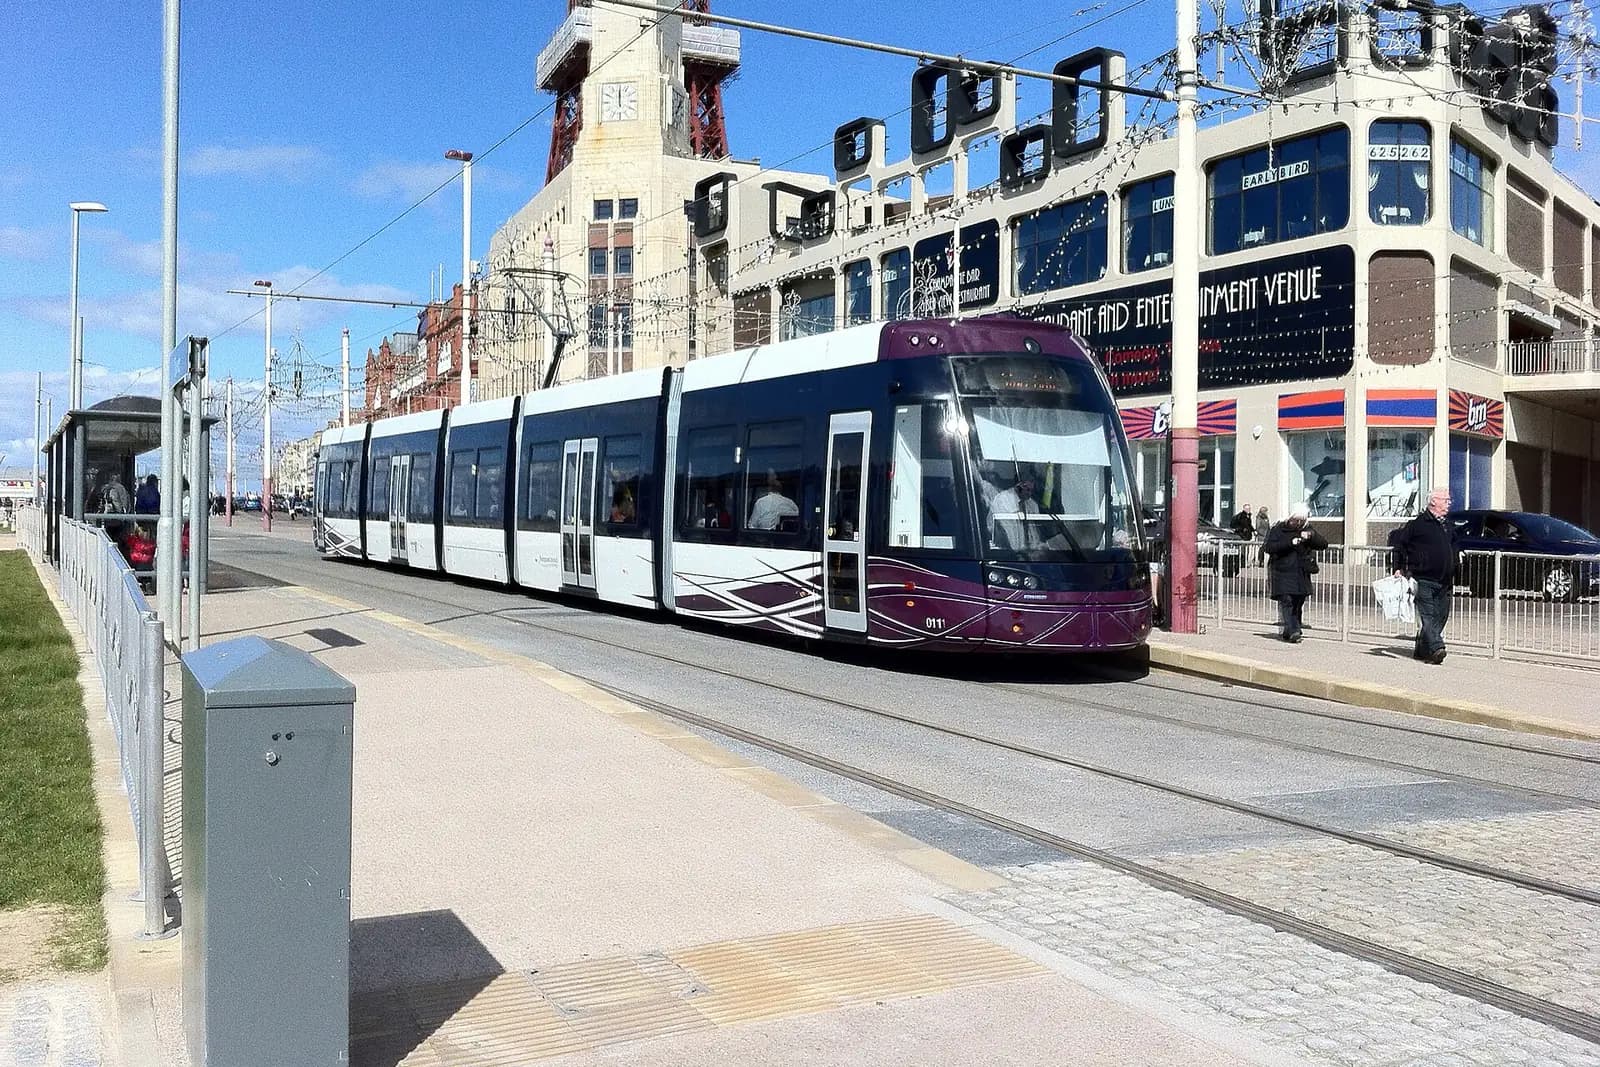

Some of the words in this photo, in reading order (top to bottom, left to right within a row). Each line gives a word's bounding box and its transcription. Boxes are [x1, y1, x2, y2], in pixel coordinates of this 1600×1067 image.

[1243, 169, 1278, 188] EARLY
[1280, 162, 1308, 178] BIRD
[1098, 302, 1130, 334] AND
[1263, 265, 1322, 306] VENUE
[1467, 398, 1488, 427] bm
